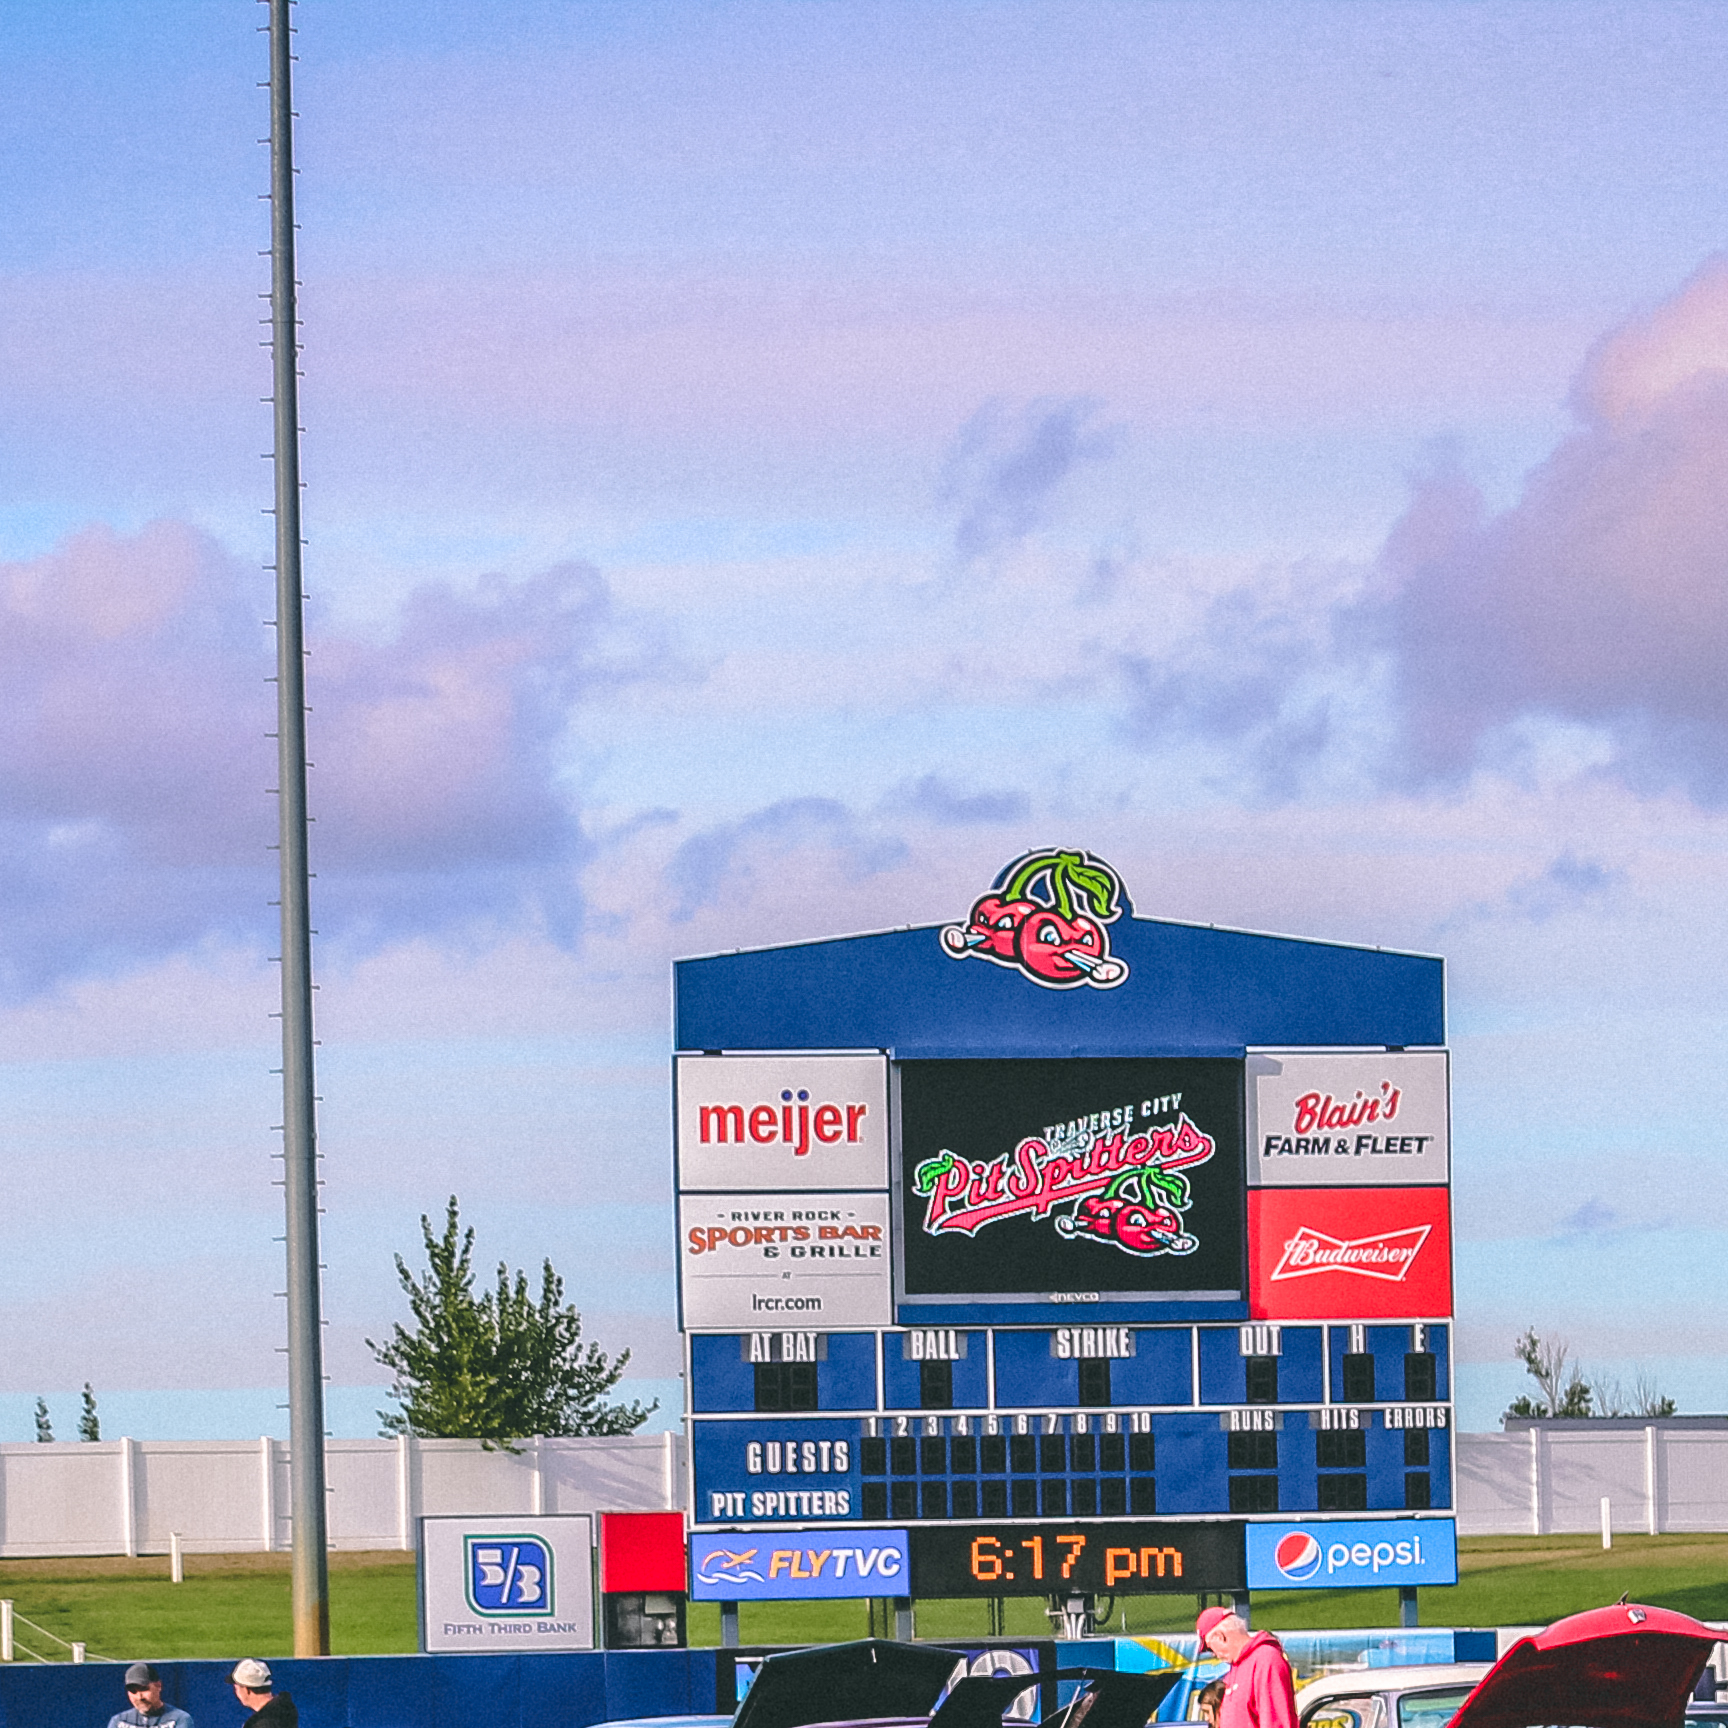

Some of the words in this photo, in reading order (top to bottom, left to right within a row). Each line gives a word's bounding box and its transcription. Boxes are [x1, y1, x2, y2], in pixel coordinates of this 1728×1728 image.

[699, 1089, 867, 1157] meijer
[1043, 1104, 1134, 1142] TRAVERSE
[1140, 1092, 1183, 1118] CITY
[1294, 1081, 1402, 1135] Blain's
[1263, 1134, 1332, 1158] FARM
[1334, 1137, 1350, 1155] &
[1353, 1133, 1430, 1156] FLEET
[926, 1153, 1008, 1225] Pit
[1007, 1116, 1213, 1212] Spitters
[731, 1211, 785, 1222] RIVER
[792, 1210, 842, 1221] ROCK
[688, 1225, 811, 1255] SPORTS
[817, 1225, 883, 1242] BAR
[763, 1245, 780, 1258] &
[790, 1244, 882, 1258] GRILLE
[1283, 1239, 1415, 1267] Budweiser
[752, 1293, 822, 1311] lrcr.com
[749, 1332, 772, 1362] AT
[781, 1330, 819, 1362] BAT
[909, 1329, 960, 1360] BALL
[1056, 1327, 1131, 1359] STRIKE
[1239, 1325, 1281, 1357] OUT
[1351, 1324, 1364, 1354] H
[1414, 1323, 1426, 1354] E
[868, 1416, 877, 1438] 1
[897, 1416, 909, 1438] 2
[927, 1416, 939, 1437] 3
[957, 1415, 968, 1437] 4
[987, 1415, 999, 1436] 5
[1016, 1415, 1028, 1436] 6
[1046, 1414, 1058, 1435] 7
[1076, 1414, 1088, 1435] 8
[1105, 1413, 1117, 1434] 9
[1130, 1412, 1151, 1433] 10
[1230, 1409, 1274, 1431] RUNS
[1321, 1408, 1359, 1430] HITS
[1384, 1407, 1447, 1429] ERRORS
[746, 1440, 850, 1474] GUESTS
[711, 1491, 746, 1518] PIT
[751, 1489, 851, 1517] SPITTERS
[769, 1547, 902, 1579] FLYTVC
[971, 1535, 1087, 1580] 6:17
[1104, 1547, 1183, 1587] pm
[1327, 1535, 1424, 1575] pepsi
[443, 1623, 484, 1637] FIFTH
[488, 1622, 533, 1635] THIRD
[536, 1621, 578, 1635] BANK
